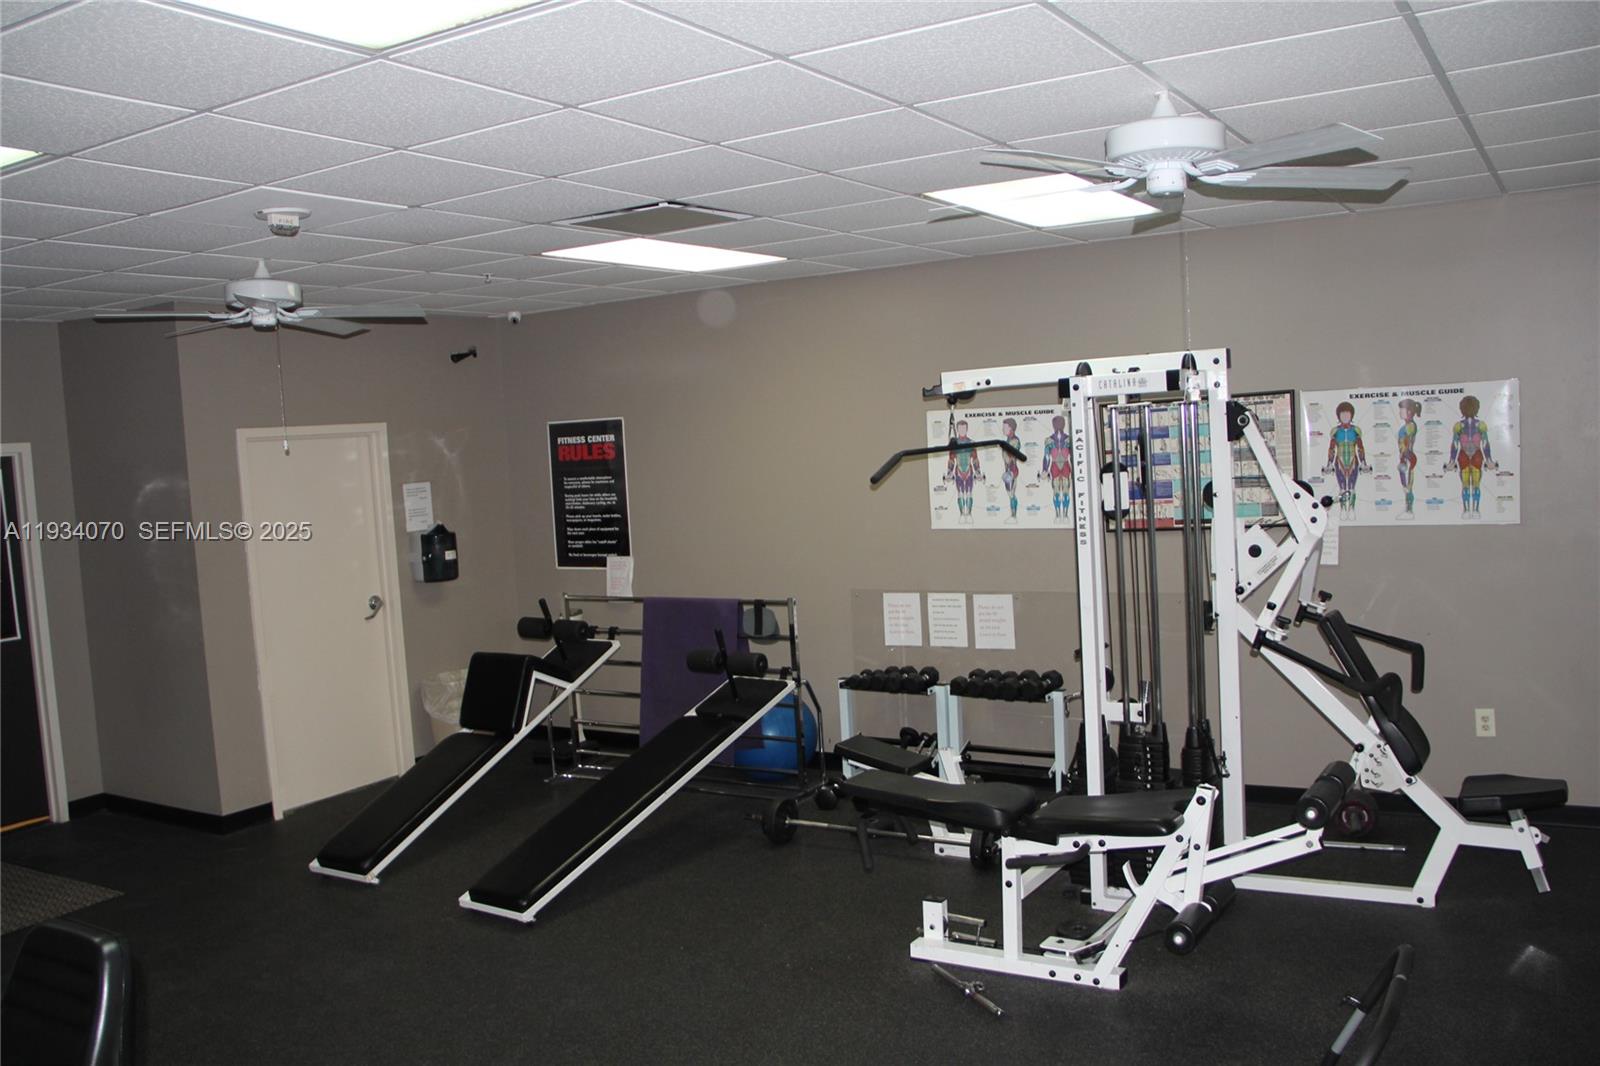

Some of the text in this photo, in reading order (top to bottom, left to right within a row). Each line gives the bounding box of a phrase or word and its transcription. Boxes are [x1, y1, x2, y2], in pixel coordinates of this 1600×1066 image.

[1098, 378, 1137, 390] CATALINA
[1349, 391, 1389, 399] EXERCISE
[557, 434, 615, 445] FITNESS CENTER
[558, 443, 616, 461] RULES
[1075, 428, 1088, 545] PACIFIC FITNESS
